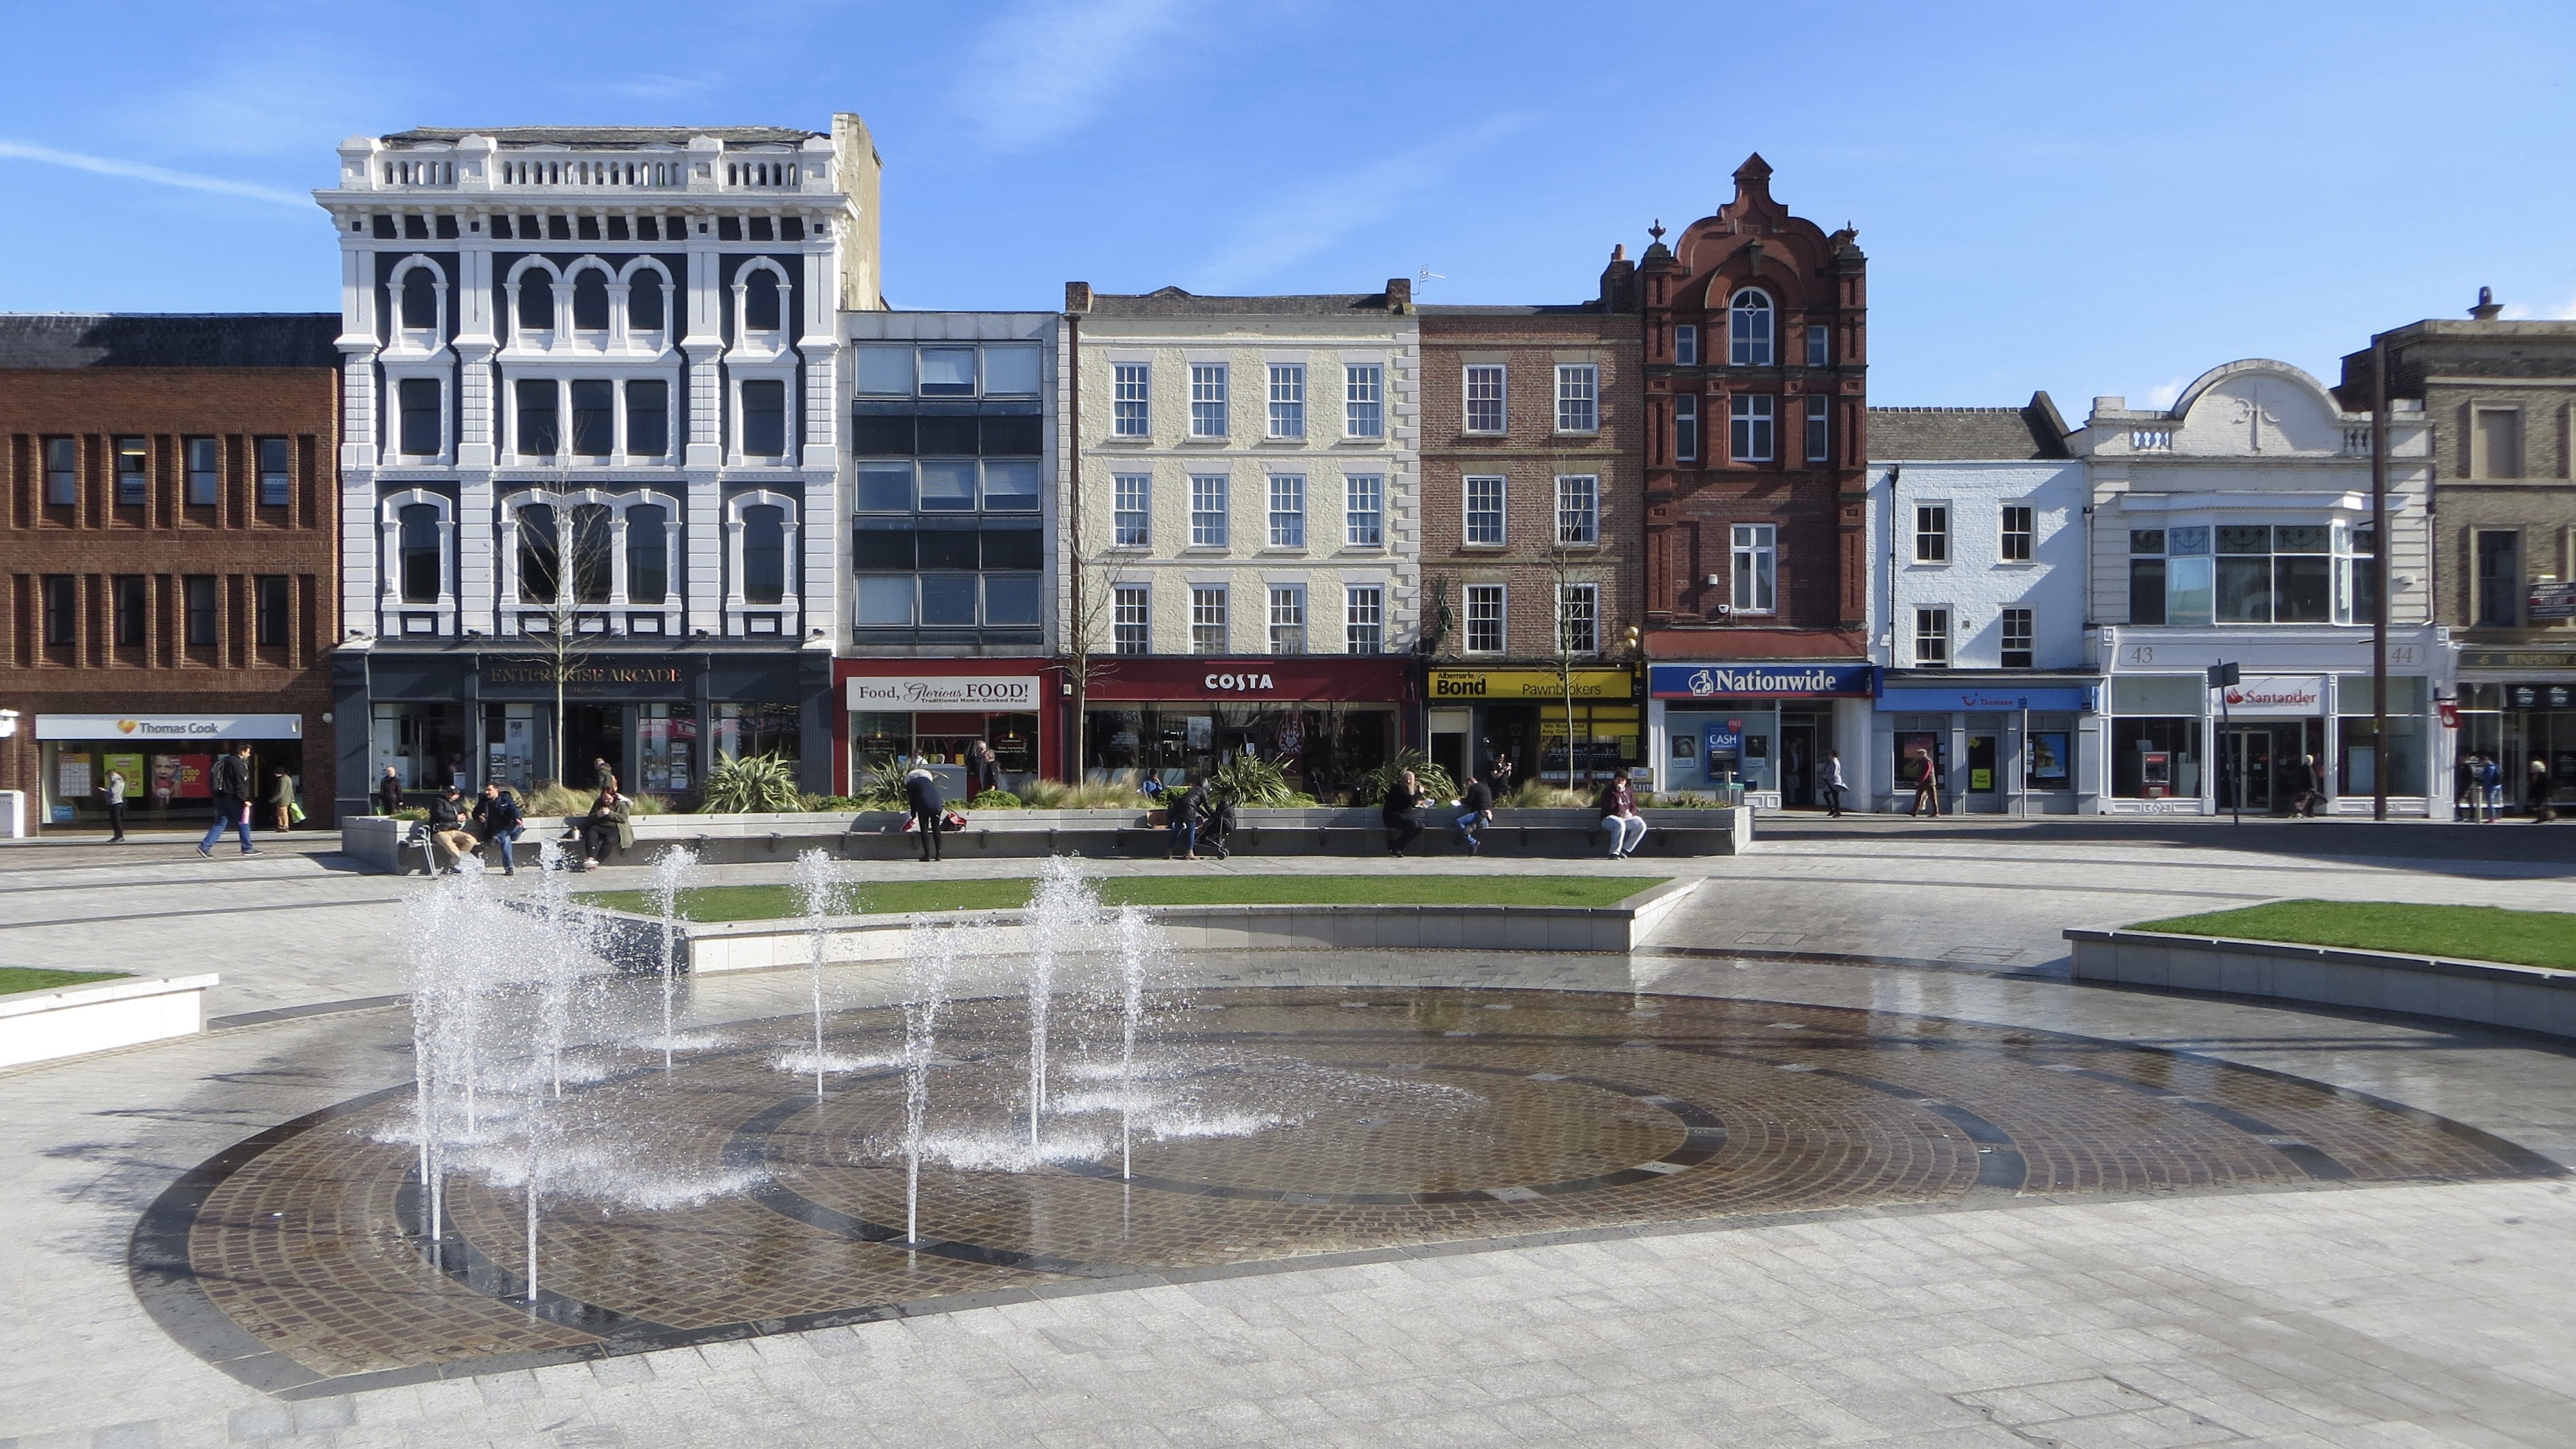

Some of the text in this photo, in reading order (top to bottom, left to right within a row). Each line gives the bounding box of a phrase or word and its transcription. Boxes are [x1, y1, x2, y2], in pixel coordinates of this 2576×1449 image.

[2131, 647, 2152, 663] 43
[2390, 647, 2412, 663] 44
[608, 668, 683, 683] ARCADE
[1205, 674, 1274, 691] COSTA
[1715, 670, 1837, 691] Nationwide
[859, 681, 1028, 703] Food, Glorious FOOD!
[1437, 678, 1602, 696] Bond Pawnbokers
[2246, 689, 2317, 703] Santander
[139, 723, 219, 734] Thomas Cook
[1710, 734, 1736, 744] CASH
